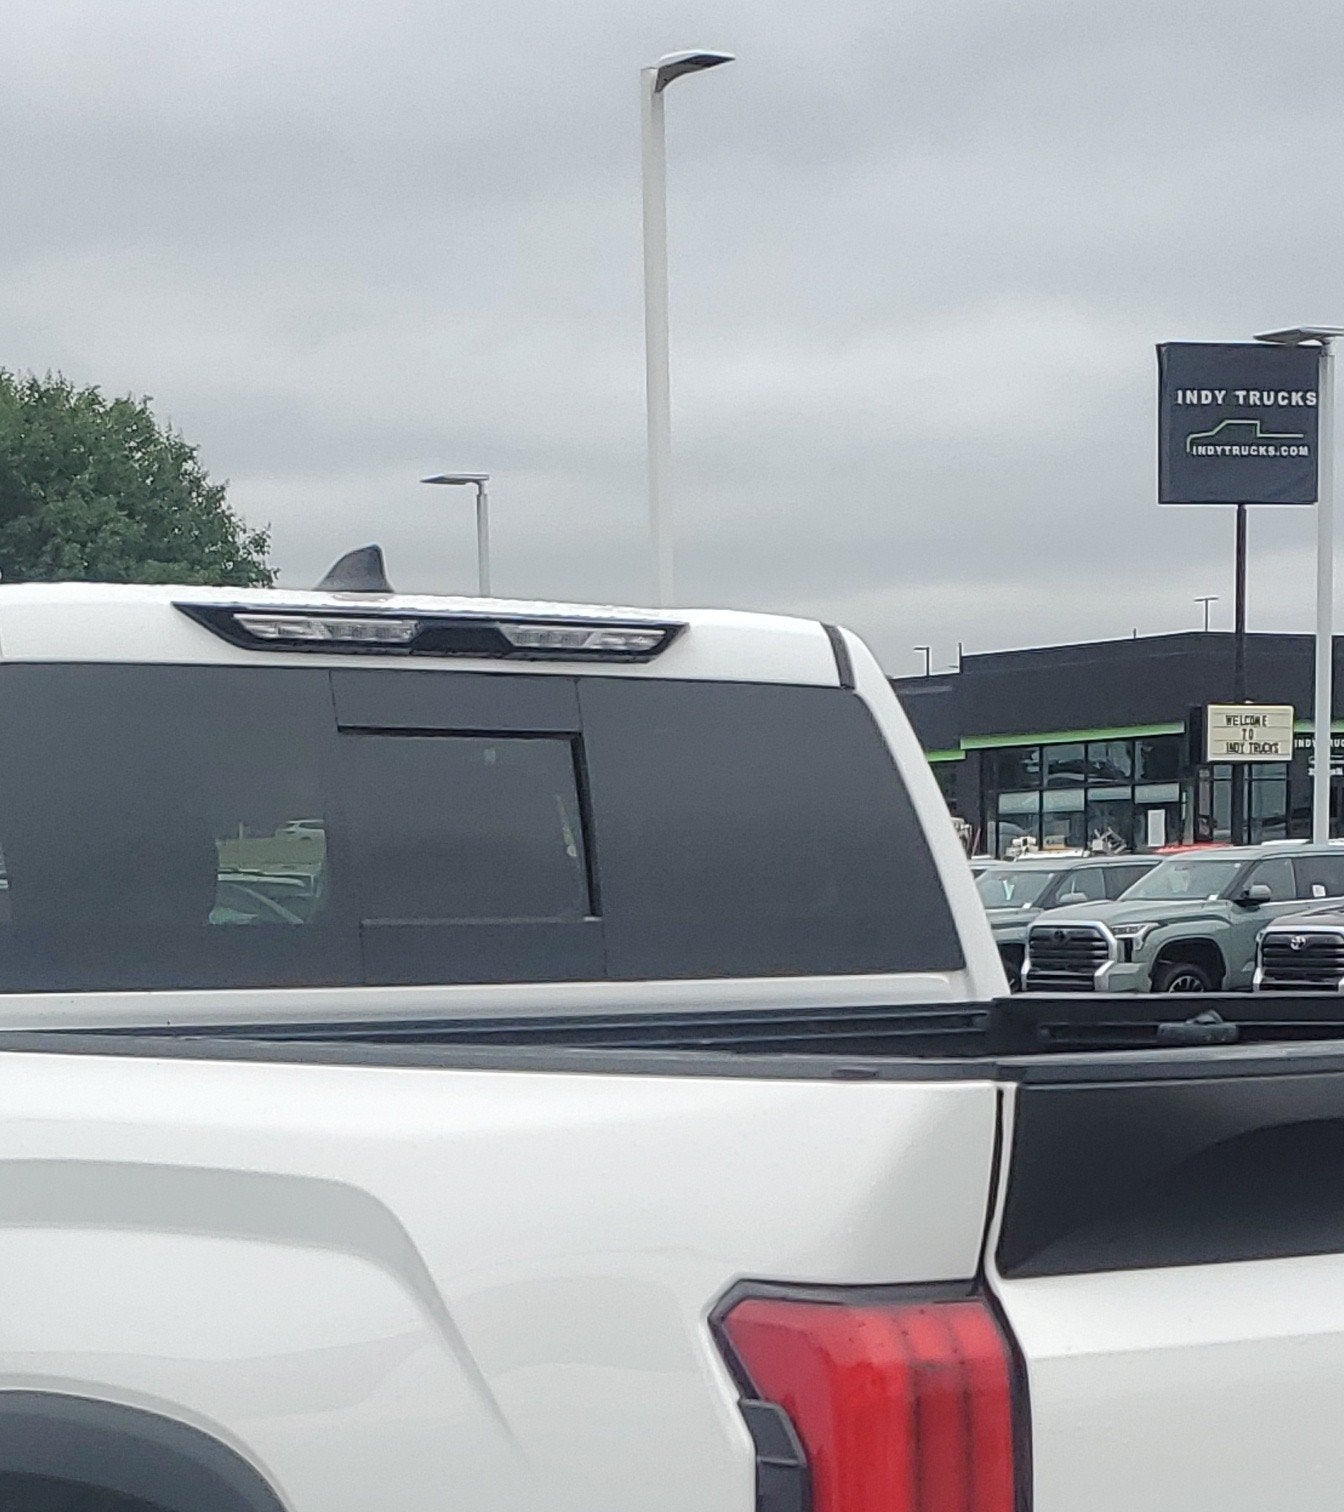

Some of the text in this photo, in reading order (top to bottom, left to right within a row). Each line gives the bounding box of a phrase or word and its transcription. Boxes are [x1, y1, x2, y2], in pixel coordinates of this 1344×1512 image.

[1175, 389, 1317, 406] INDY TRUCKS
[1192, 445, 1309, 457] INDYTRUCKS.COM
[1225, 714, 1268, 727] WELCOME
[1241, 728, 1254, 741] TO
[1226, 741, 1245, 754] INDY
